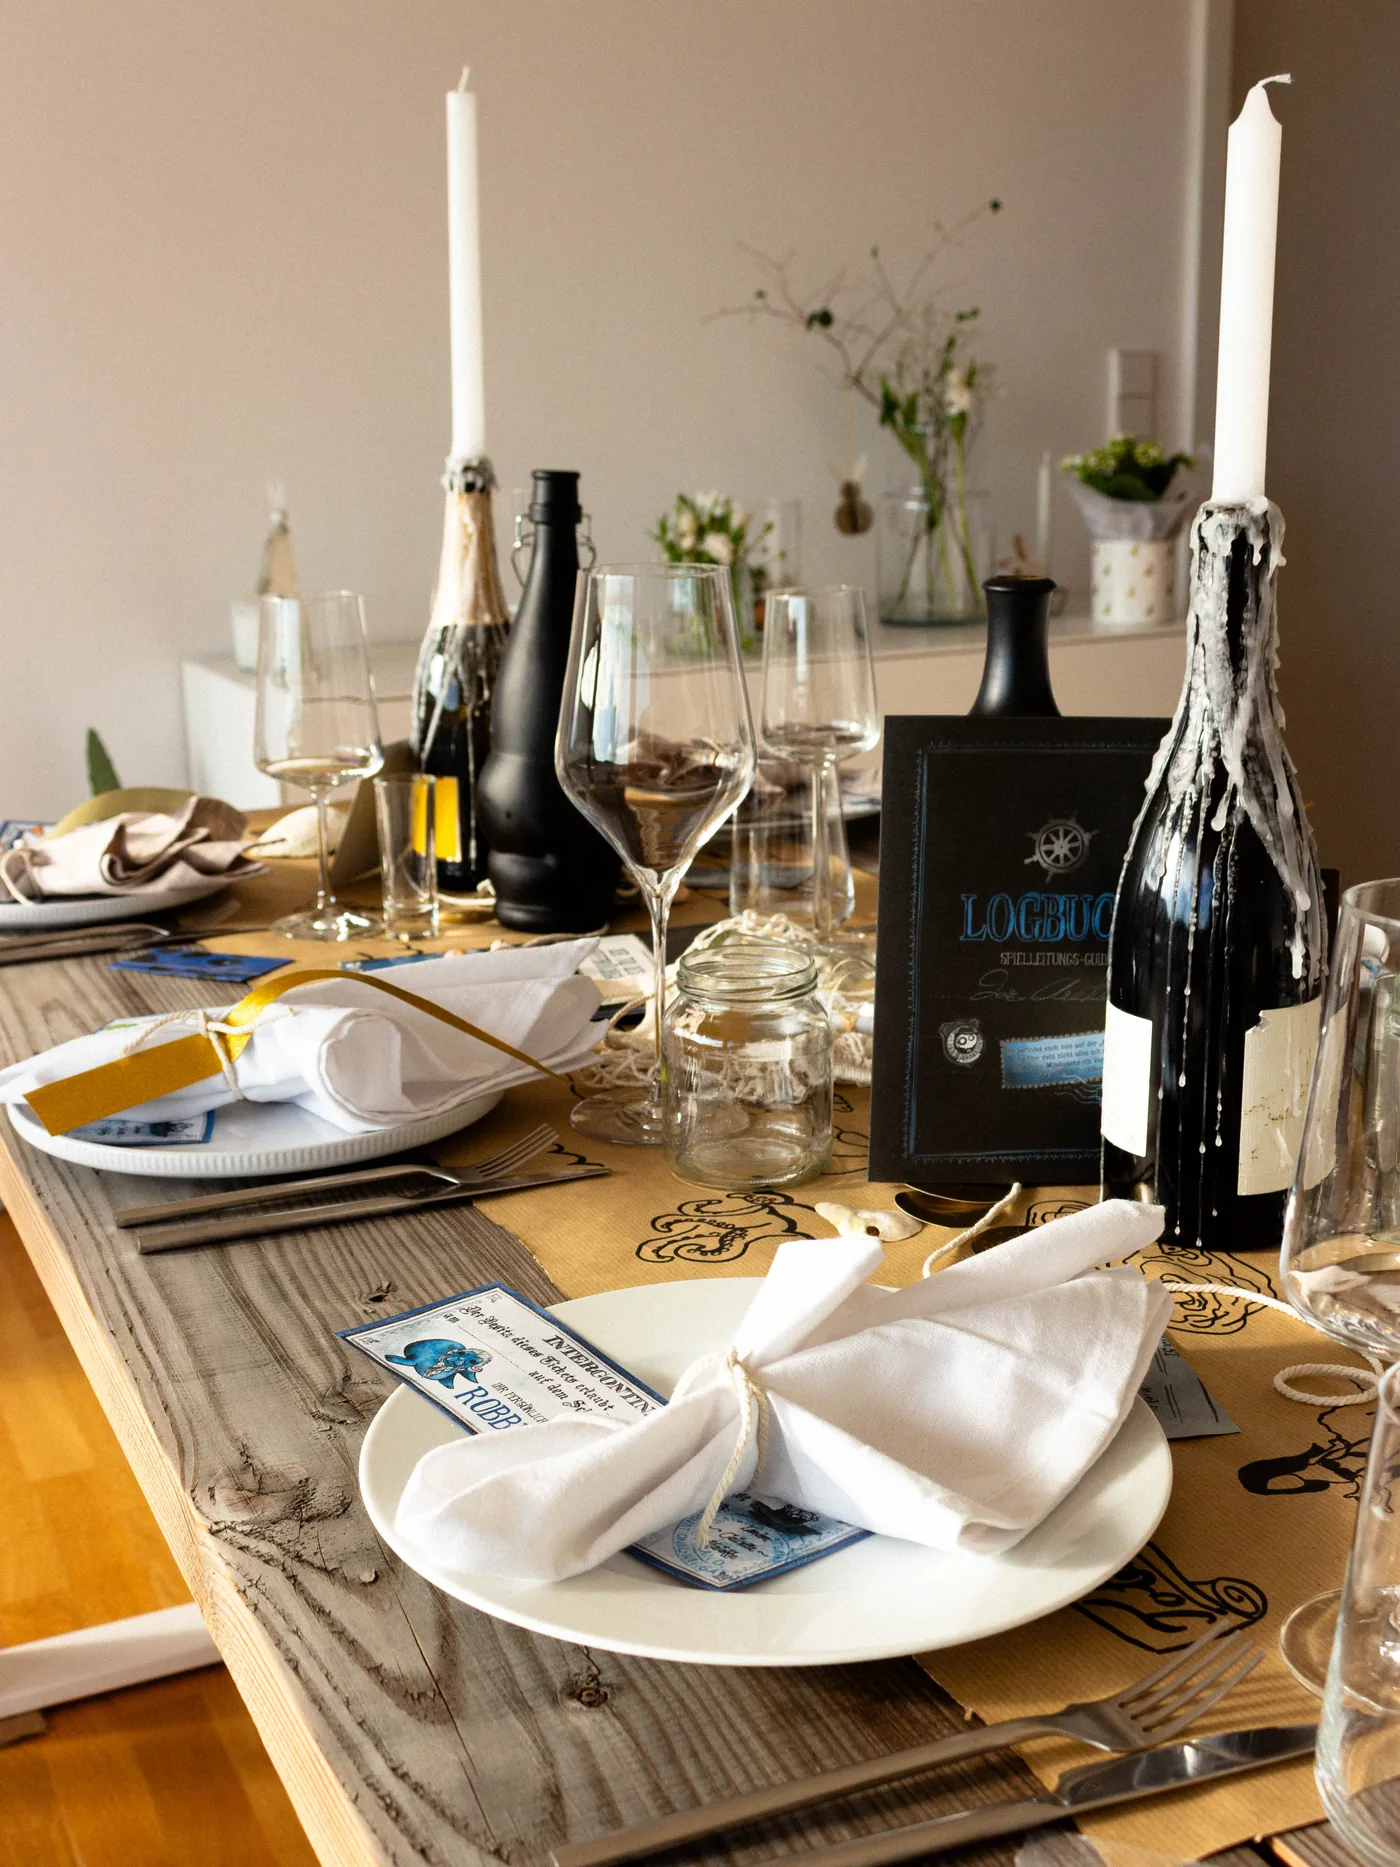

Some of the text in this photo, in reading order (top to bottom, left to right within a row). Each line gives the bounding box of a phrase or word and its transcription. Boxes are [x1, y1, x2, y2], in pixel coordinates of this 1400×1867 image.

[959, 892, 1115, 942] LOGBUC
[1000, 952, 1108, 966] SPIELLEITUNGS-GUID
[491, 1381, 509, 1393] IHR
[511, 1337, 544, 1357] dieses
[539, 1355, 578, 1384] Tickets
[575, 1384, 615, 1411] erlaubt
[528, 1370, 554, 1384] auf
[548, 1384, 569, 1400] dem
[542, 1334, 657, 1417] INTERCONTIN
[454, 1385, 528, 1430] ROBB
